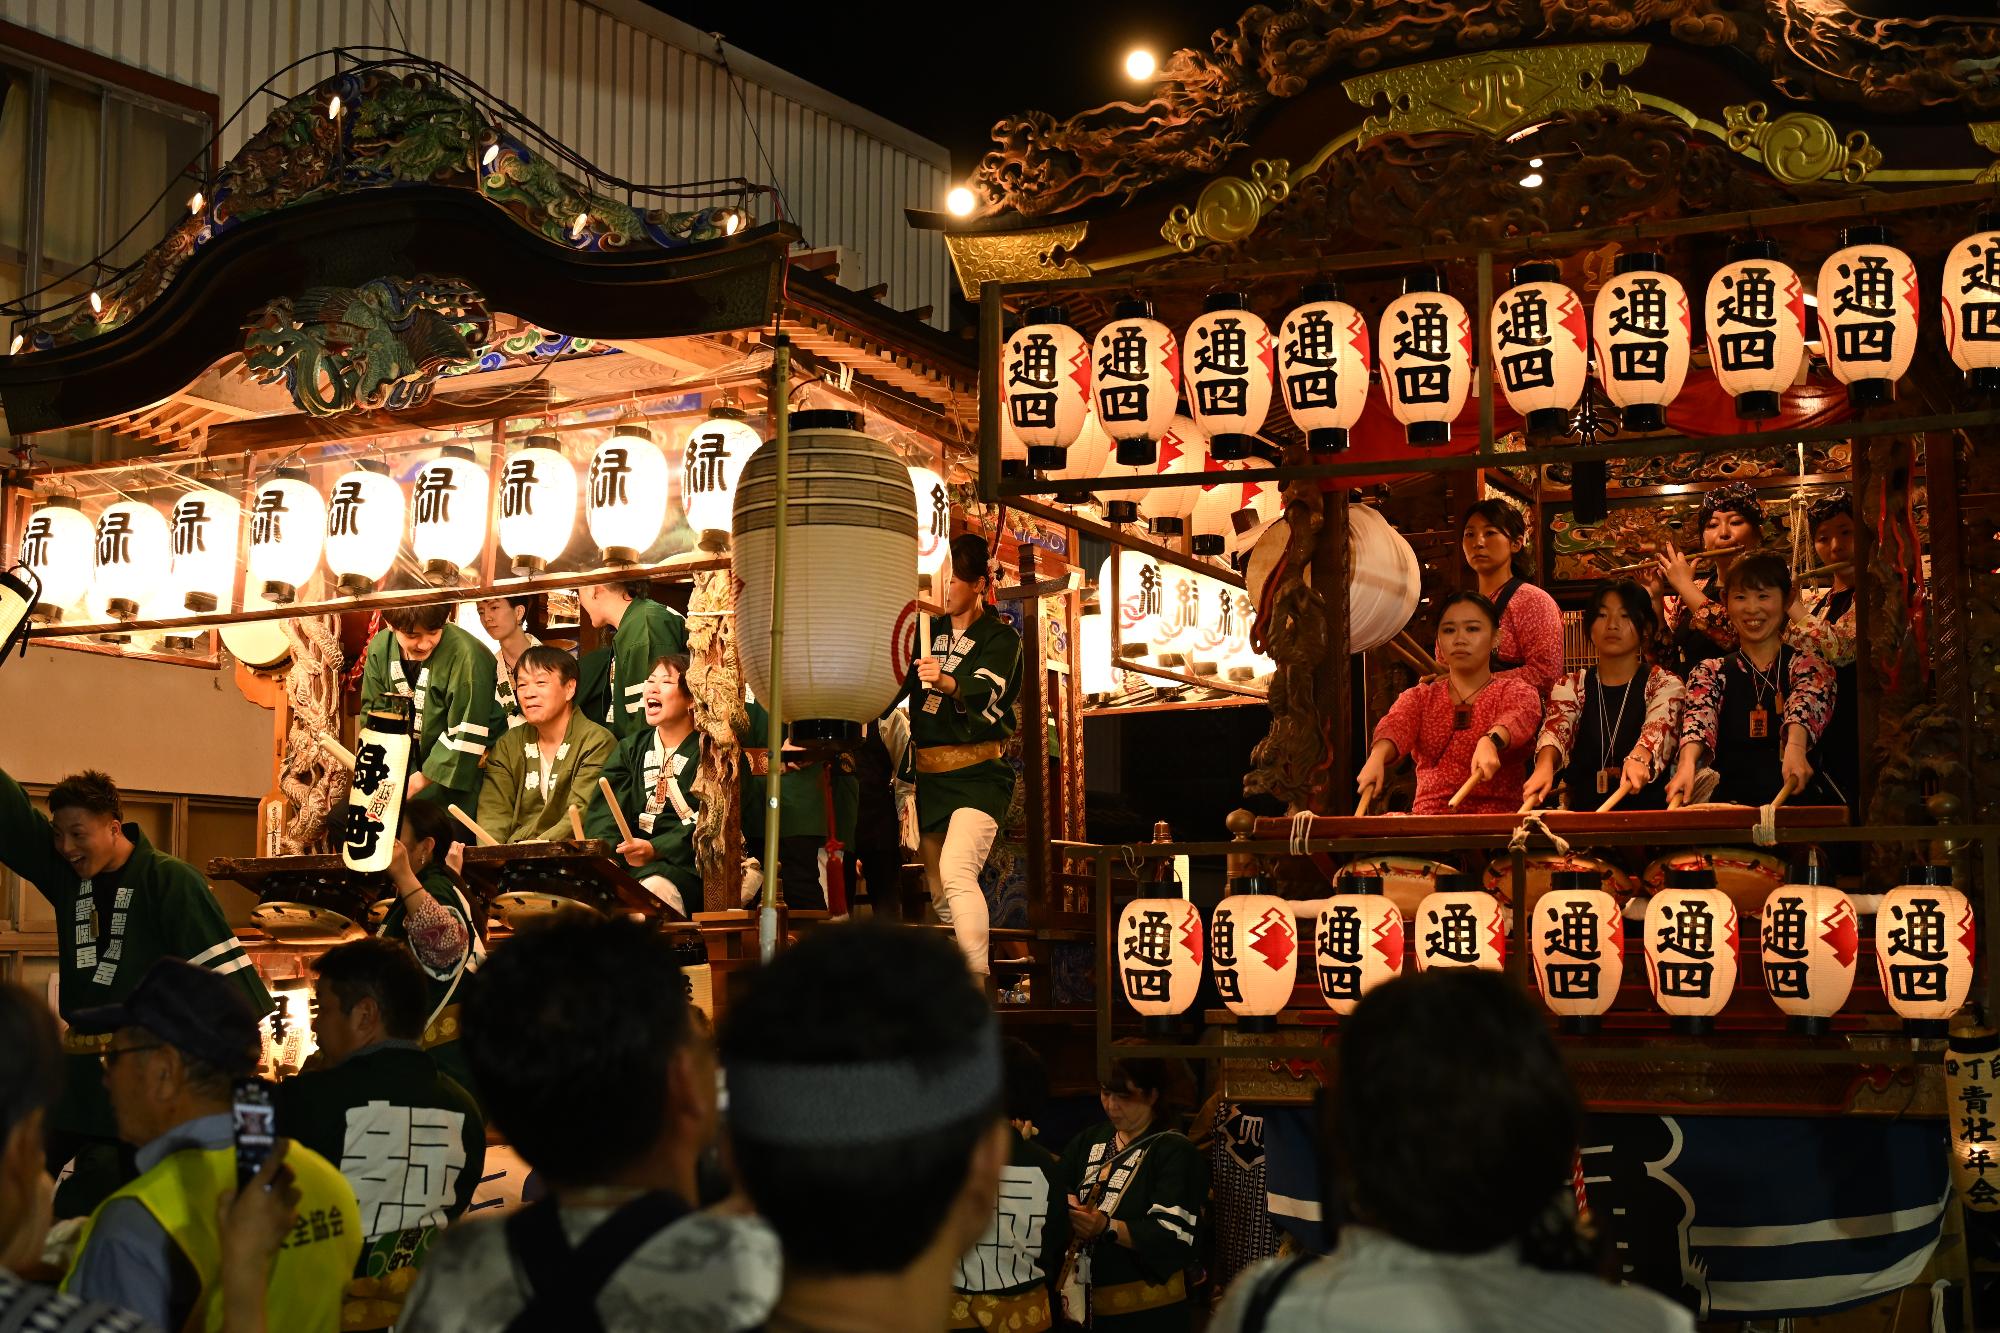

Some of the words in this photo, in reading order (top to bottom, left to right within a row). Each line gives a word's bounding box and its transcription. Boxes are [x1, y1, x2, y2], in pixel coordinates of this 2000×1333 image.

[1284, 309, 1338, 410] 通四
[1394, 302, 1452, 405] 通四
[1497, 288, 1555, 393] 通四
[1609, 278, 1670, 383] 通四
[1716, 267, 1777, 371] 通四
[1832, 255, 1896, 363] 通四
[1008, 333, 1059, 429] 通四
[1097, 325, 1150, 423] 通四
[1193, 318, 1249, 417] 通四
[1123, 910, 1174, 1003] 通四
[1318, 905, 1364, 1001] 通四
[1425, 903, 1481, 972] 通
[1543, 901, 1602, 999] 通四
[1657, 901, 1715, 999] 通四
[1762, 897, 1810, 1000] 通四
[1887, 899, 1949, 1001] 通四
[1958, 1085, 2000, 1205] 青壮年会
